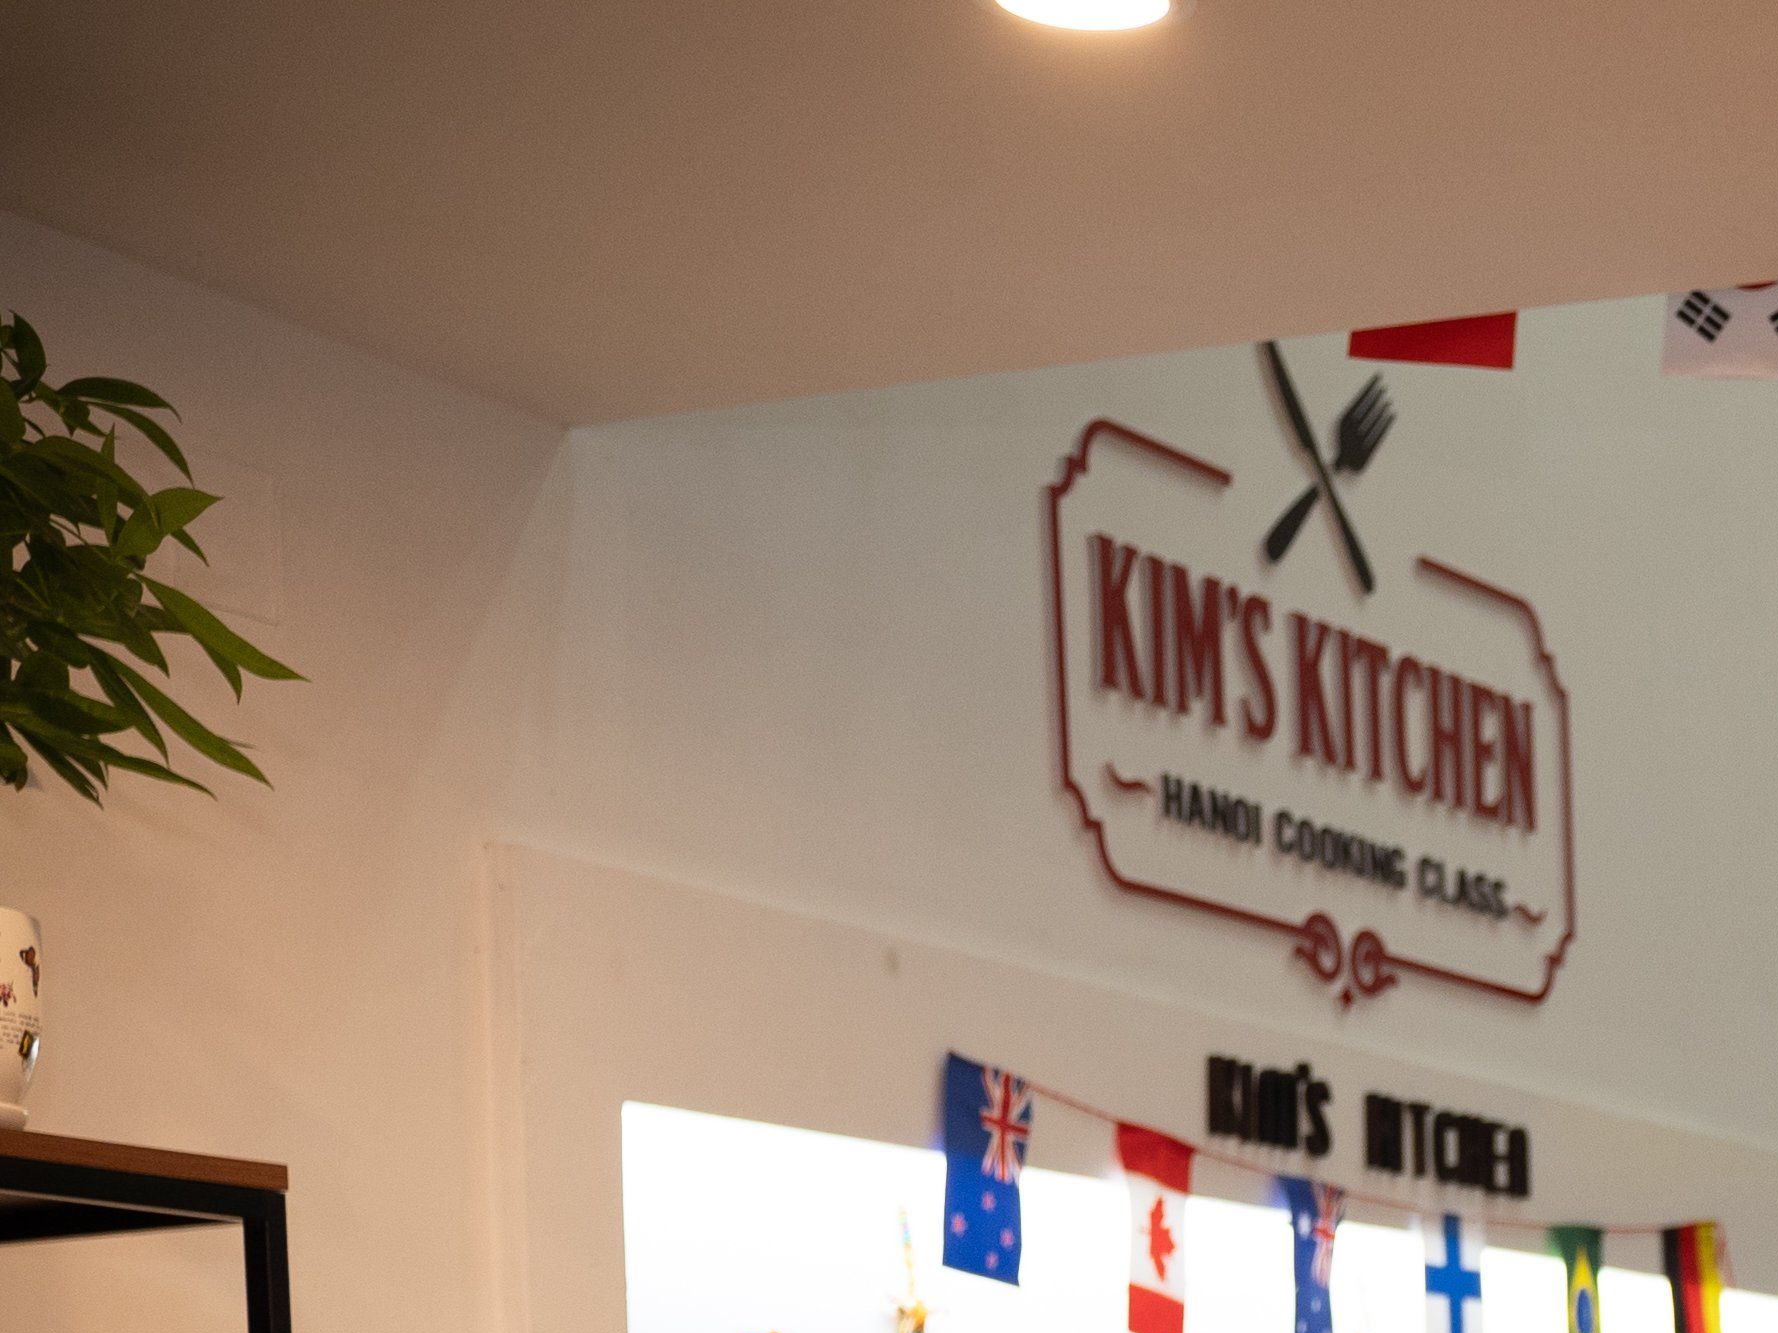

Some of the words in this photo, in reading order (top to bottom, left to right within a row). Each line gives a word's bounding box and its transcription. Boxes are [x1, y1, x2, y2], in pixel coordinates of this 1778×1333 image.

[1093, 530, 1276, 739] KIM'S
[1291, 612, 1535, 834] KITCHEN
[1161, 773, 1262, 847] HANOI
[1274, 809, 1407, 890] COOKING
[1416, 854, 1508, 919] CLASS
